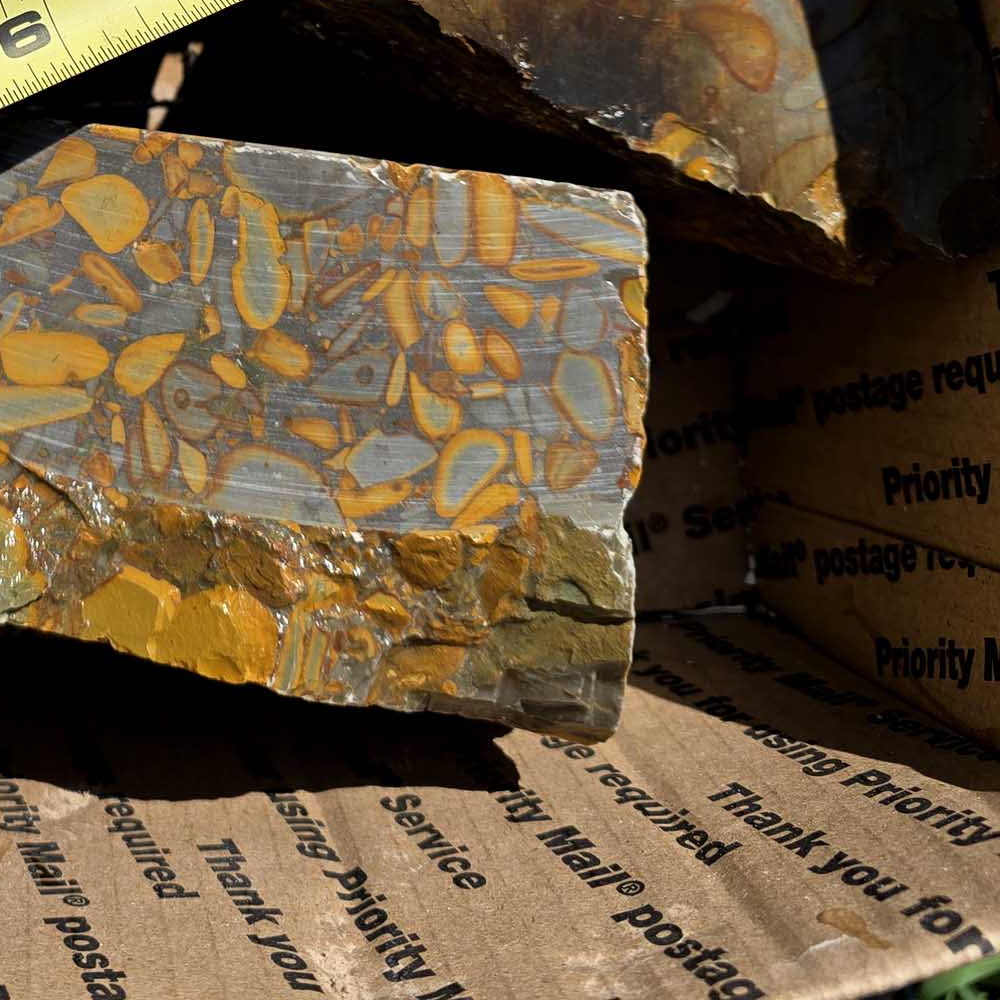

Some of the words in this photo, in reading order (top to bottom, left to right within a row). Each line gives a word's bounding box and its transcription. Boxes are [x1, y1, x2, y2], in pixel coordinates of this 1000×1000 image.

[0, 10, 53, 60] 6
[879, 456, 992, 506] Priority
[811, 537, 918, 585] postage
[873, 635, 976, 690] Priority
[584, 762, 743, 867] required
[742, 724, 854, 778] using
[839, 767, 1000, 848] Priority
[379, 793, 487, 890] Service
[706, 781, 830, 859] Thank
[807, 850, 911, 903] you
[900, 894, 997, 957] for
[197, 837, 284, 926] Thank
[247, 934, 326, 995] you
[322, 865, 437, 984] Priority
